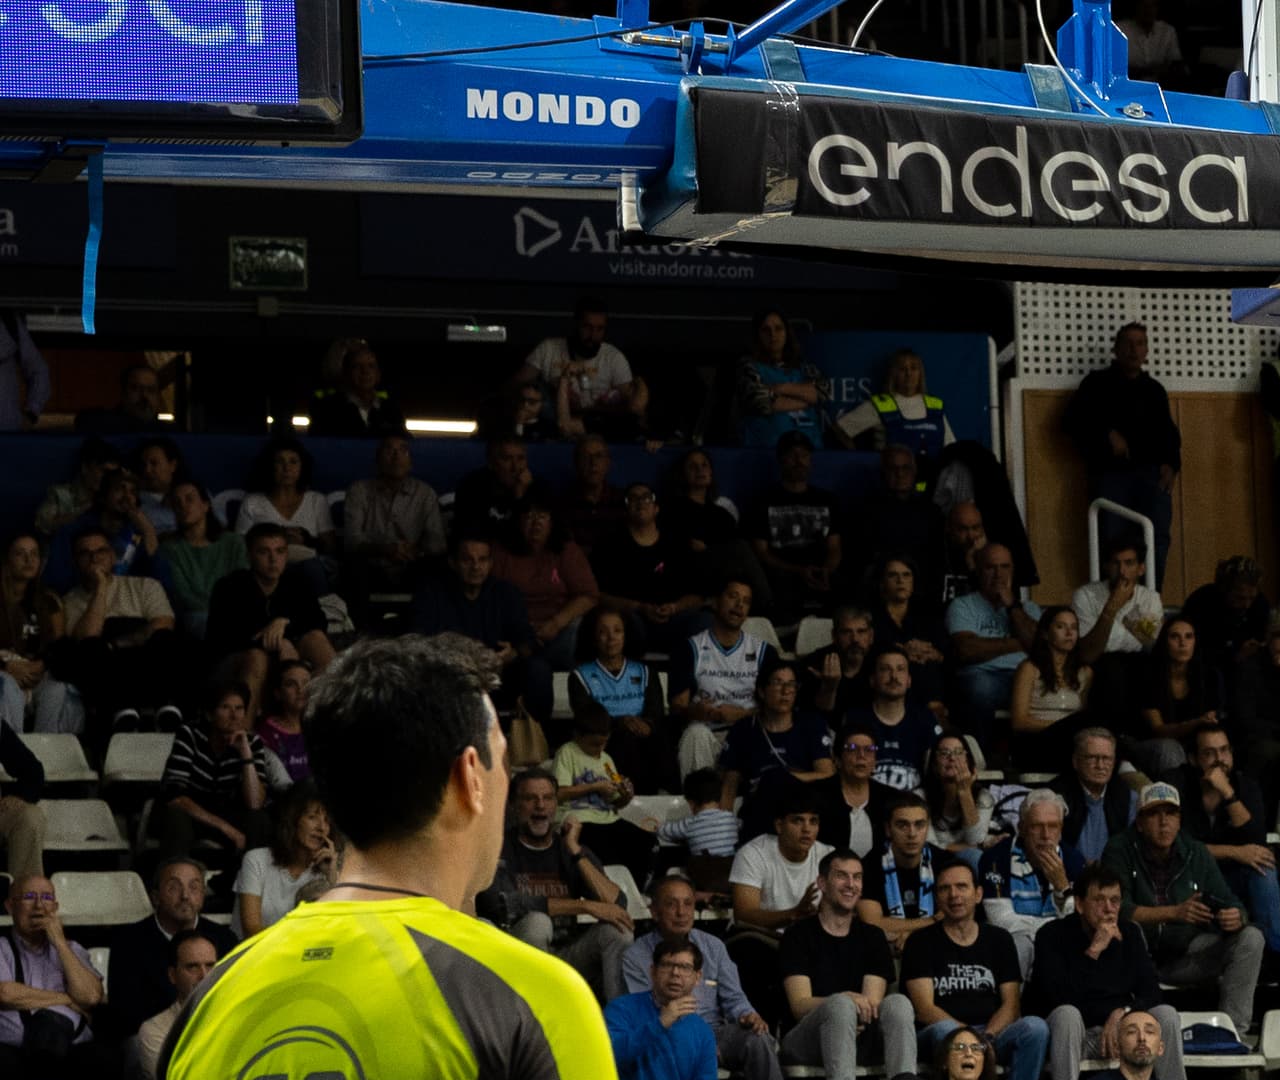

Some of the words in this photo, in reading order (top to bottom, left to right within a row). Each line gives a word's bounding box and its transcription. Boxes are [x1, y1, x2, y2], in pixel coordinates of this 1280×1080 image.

[466, 87, 642, 129] MONDO
[807, 125, 1249, 224] endesa
[948, 964, 975, 977] THE
